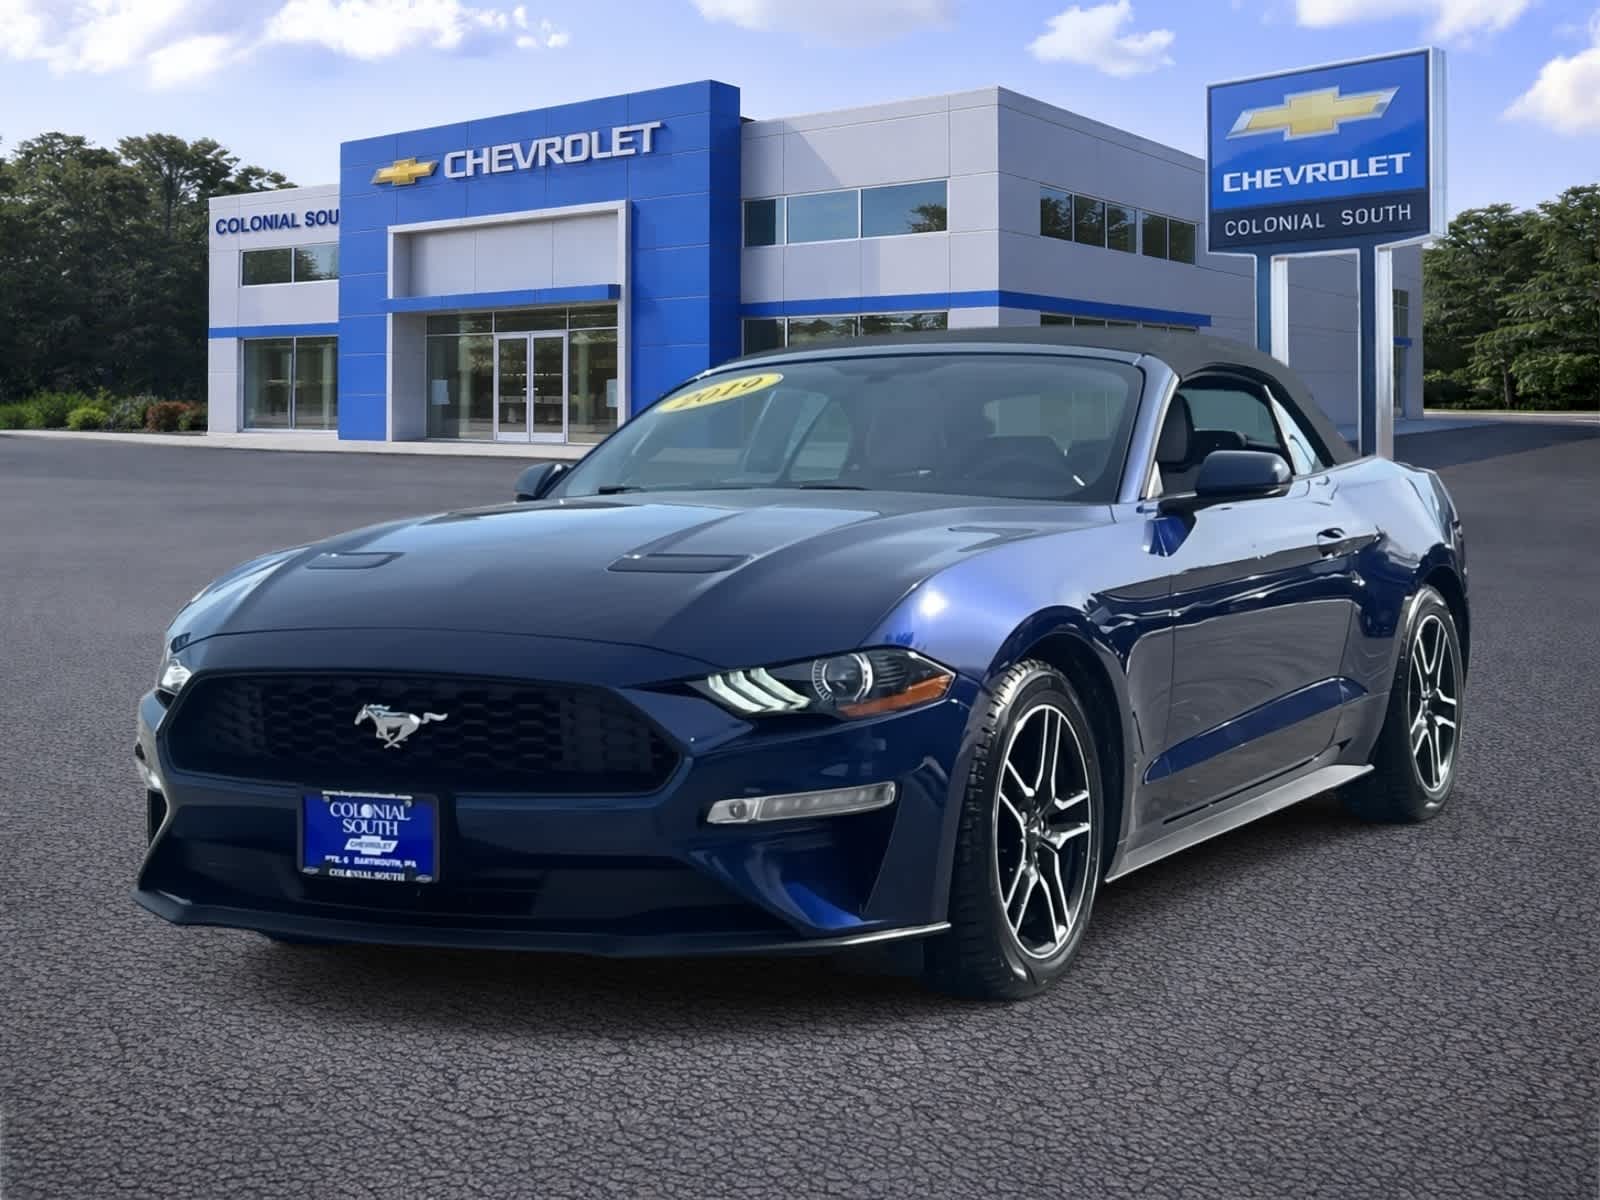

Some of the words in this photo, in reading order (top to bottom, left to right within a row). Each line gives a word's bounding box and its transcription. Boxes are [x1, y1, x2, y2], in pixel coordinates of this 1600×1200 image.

[444, 121, 662, 179] CHEVROLET
[1223, 152, 1411, 192] CHEVROLET
[215, 212, 301, 235] COLONIAL
[1225, 212, 1325, 236] COLONIAL
[1341, 204, 1411, 226] SOUTH
[330, 802, 411, 820] COLONIAL
[343, 819, 398, 836] SOUTH
